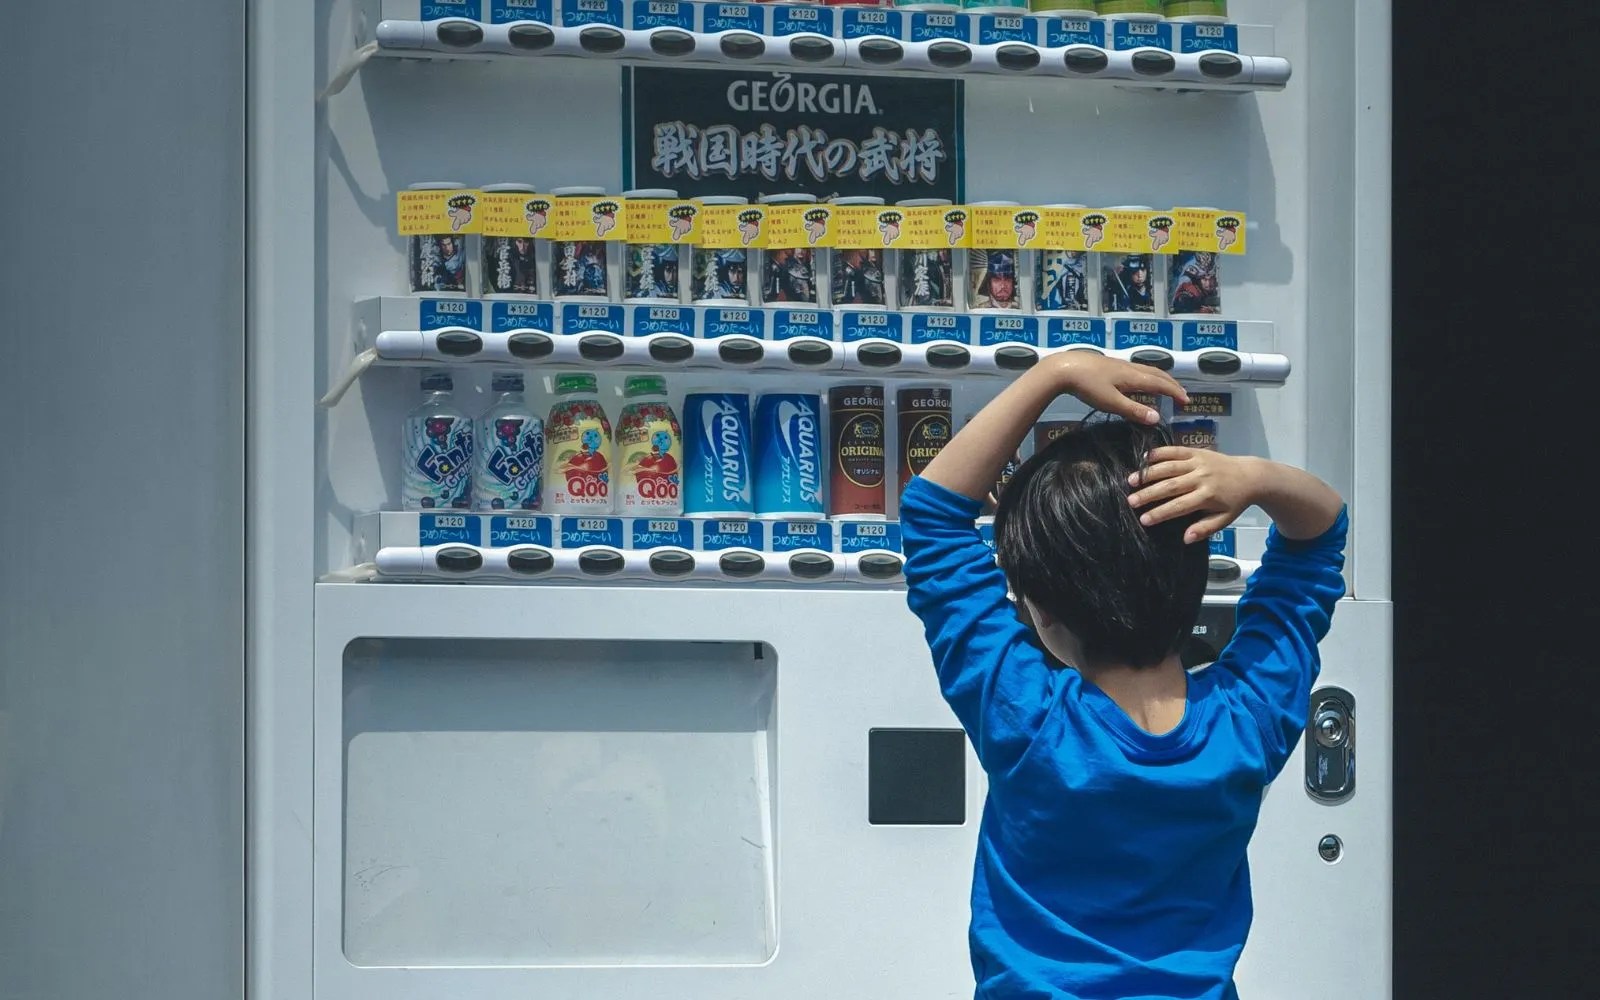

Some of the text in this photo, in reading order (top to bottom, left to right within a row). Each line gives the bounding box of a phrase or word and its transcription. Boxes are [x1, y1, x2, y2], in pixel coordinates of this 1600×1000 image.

[652, 4, 676, 12] ¥120
[722, 7, 746, 15] ¥120
[792, 10, 816, 18] ¥120
[861, 13, 885, 22] ¥120
[929, 16, 953, 24] ¥120
[997, 19, 1021, 27] ¥120
[1064, 22, 1088, 30] ¥120
[1131, 24, 1155, 33] ¥120
[1198, 27, 1222, 36] ¥120
[727, 72, 877, 114] GEORGIA
[653, 121, 945, 184] 戦国時代の武将
[439, 304, 464, 312] ¥120
[511, 306, 535, 314] ¥120
[582, 308, 606, 316] ¥120
[652, 310, 677, 318] ¥120
[723, 312, 747, 320] ¥120
[792, 314, 816, 322] ¥120
[860, 316, 885, 324] ¥120
[930, 318, 954, 326] ¥120
[998, 320, 1022, 328] ¥120
[1065, 321, 1088, 330] ¥120
[1132, 324, 1155, 332] ¥120
[1200, 325, 1223, 333] ¥120
[721, 400, 740, 502] AQUARIUS
[798, 400, 815, 503] AQUARIUS
[910, 447, 941, 458] ORIG
[568, 477, 608, 498] Qoo
[638, 478, 678, 499] Qoo
[438, 518, 463, 526] ¥120
[509, 520, 534, 528] ¥120
[580, 521, 604, 529] ¥120
[651, 522, 676, 530] ¥120
[722, 524, 746, 532] ¥120
[791, 525, 814, 533] ¥120
[859, 526, 884, 534] ¥120
